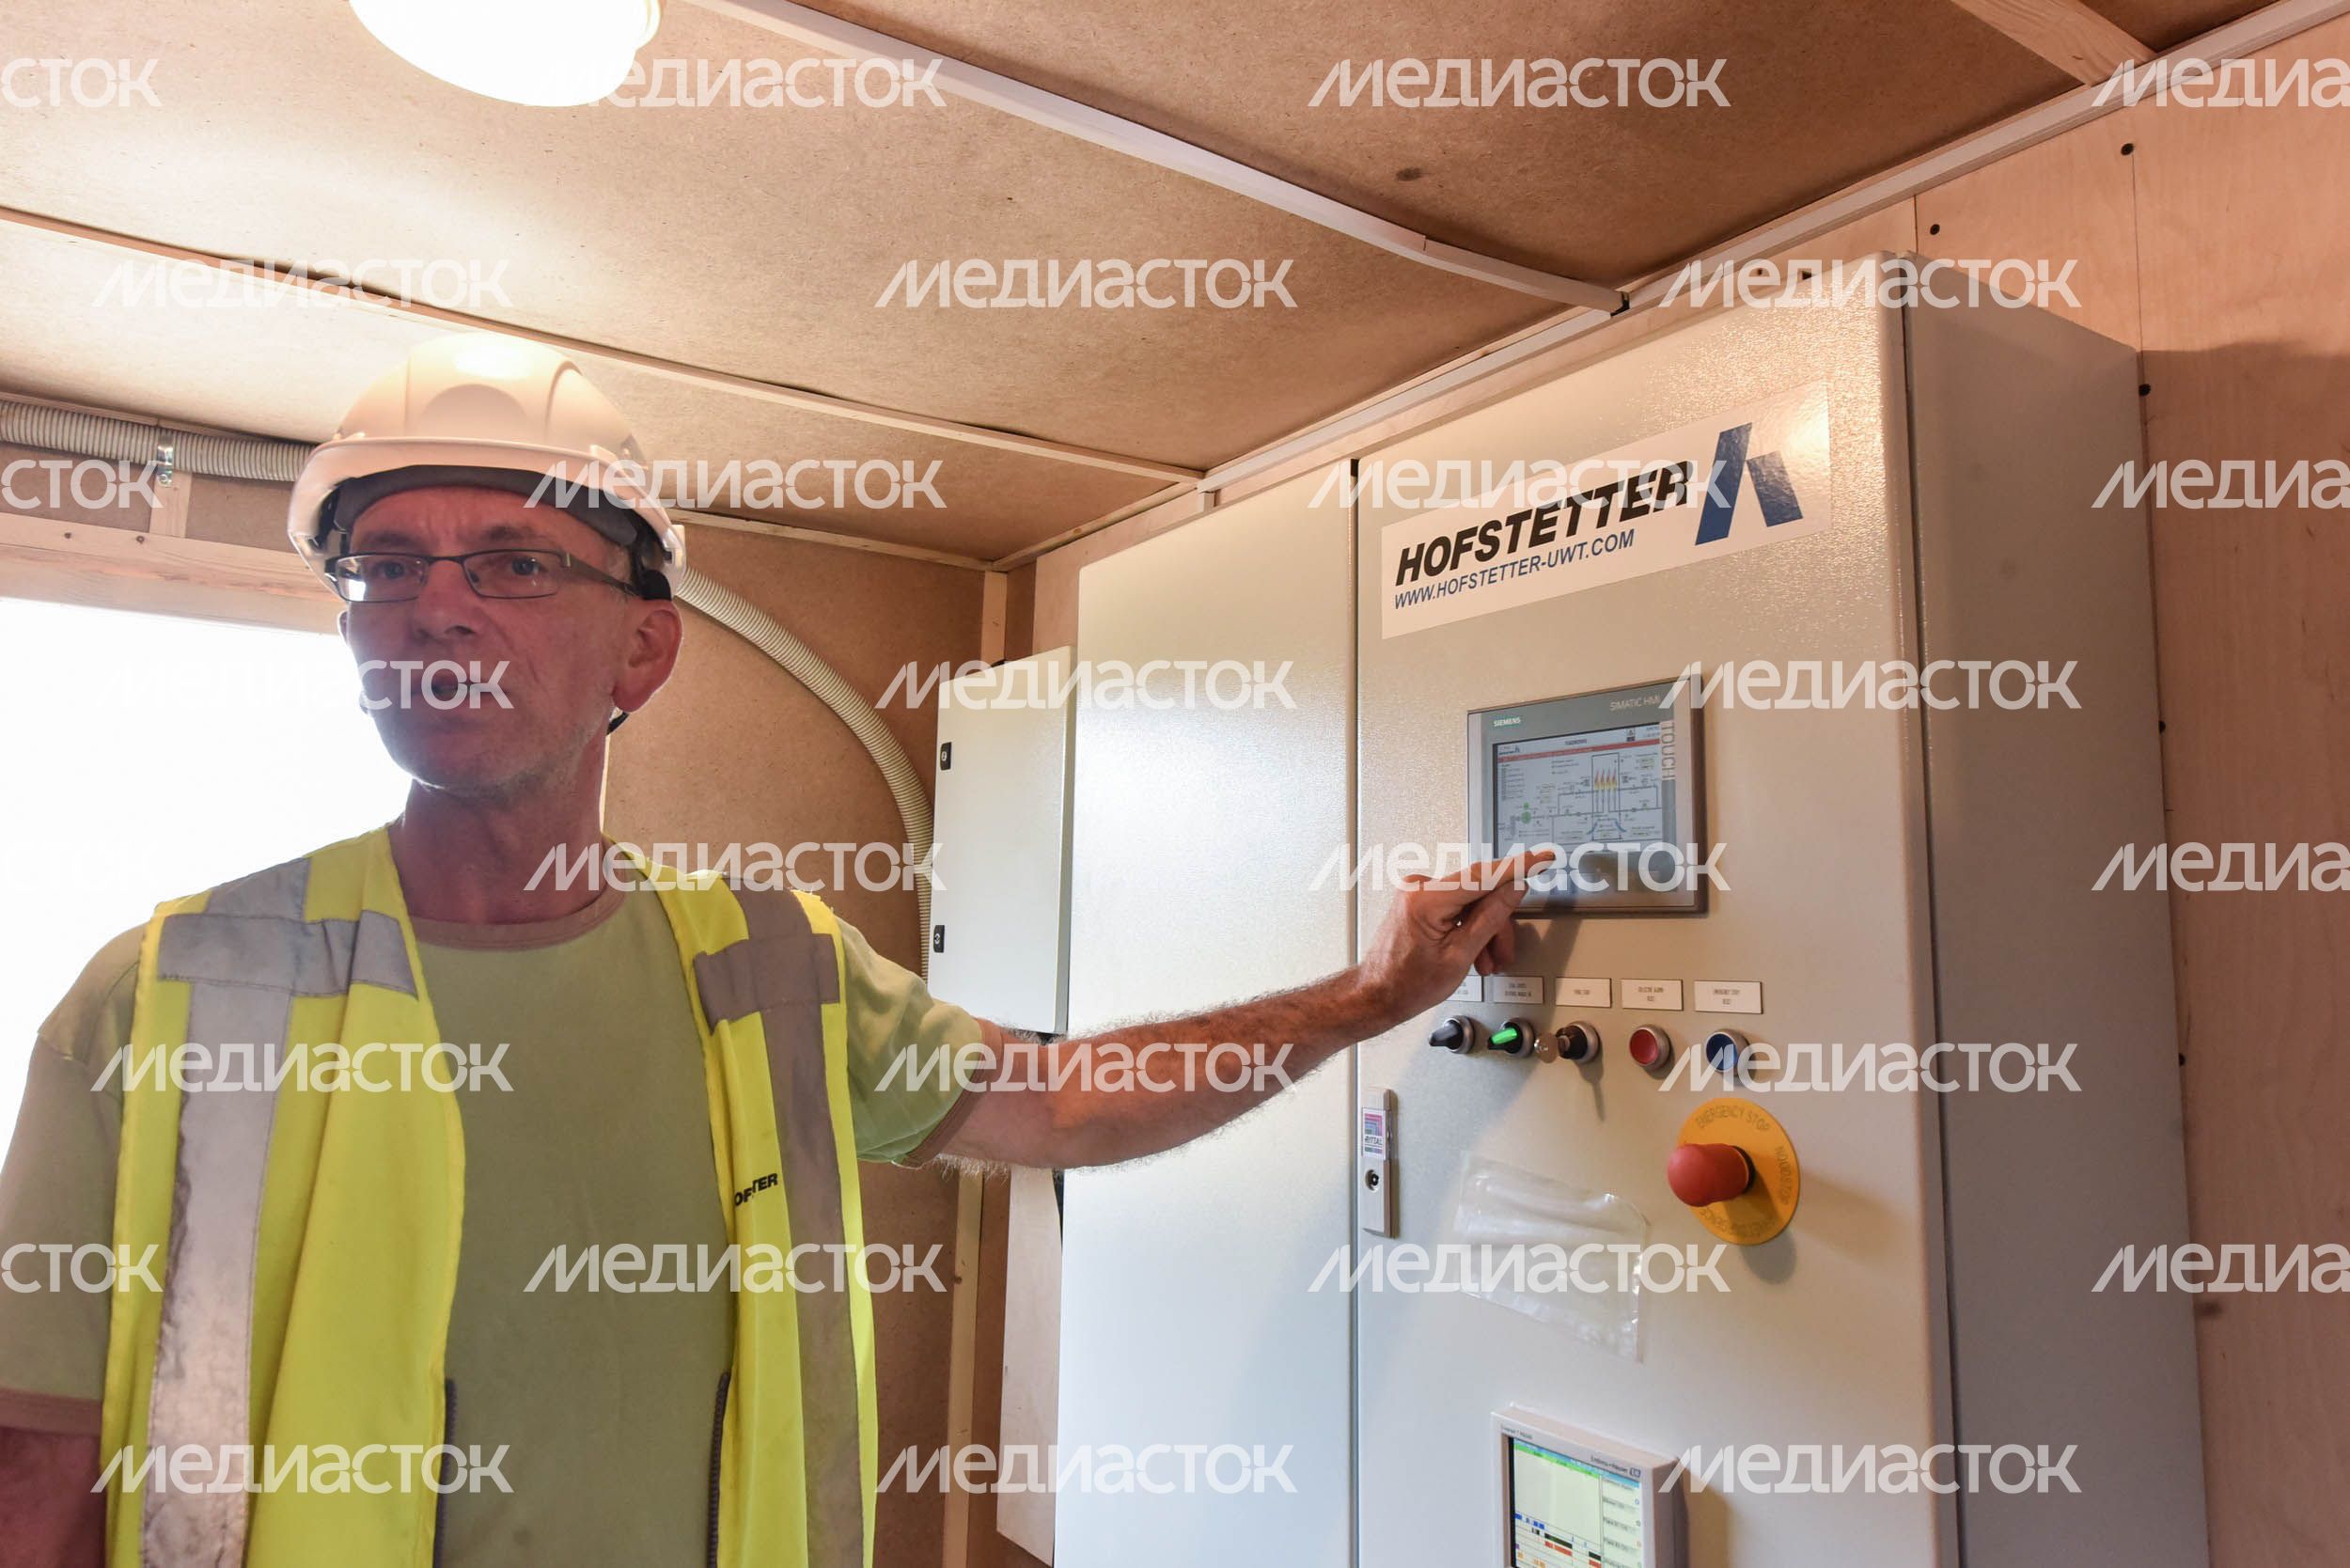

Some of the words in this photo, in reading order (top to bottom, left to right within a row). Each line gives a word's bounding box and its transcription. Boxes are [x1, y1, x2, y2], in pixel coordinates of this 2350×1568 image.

[1395, 461, 1693, 586] HOFSTETTER
[1394, 528, 1635, 609] WWW.HOFSTETTER-UWT.COM
[1493, 717, 1521, 728] SIEMENS
[1609, 698, 1641, 712] SIMATIC
[1661, 721, 1676, 778] TOUCH
[1695, 1105, 1745, 1130] EMERGENCY
[1746, 1110, 1771, 1131] STOP
